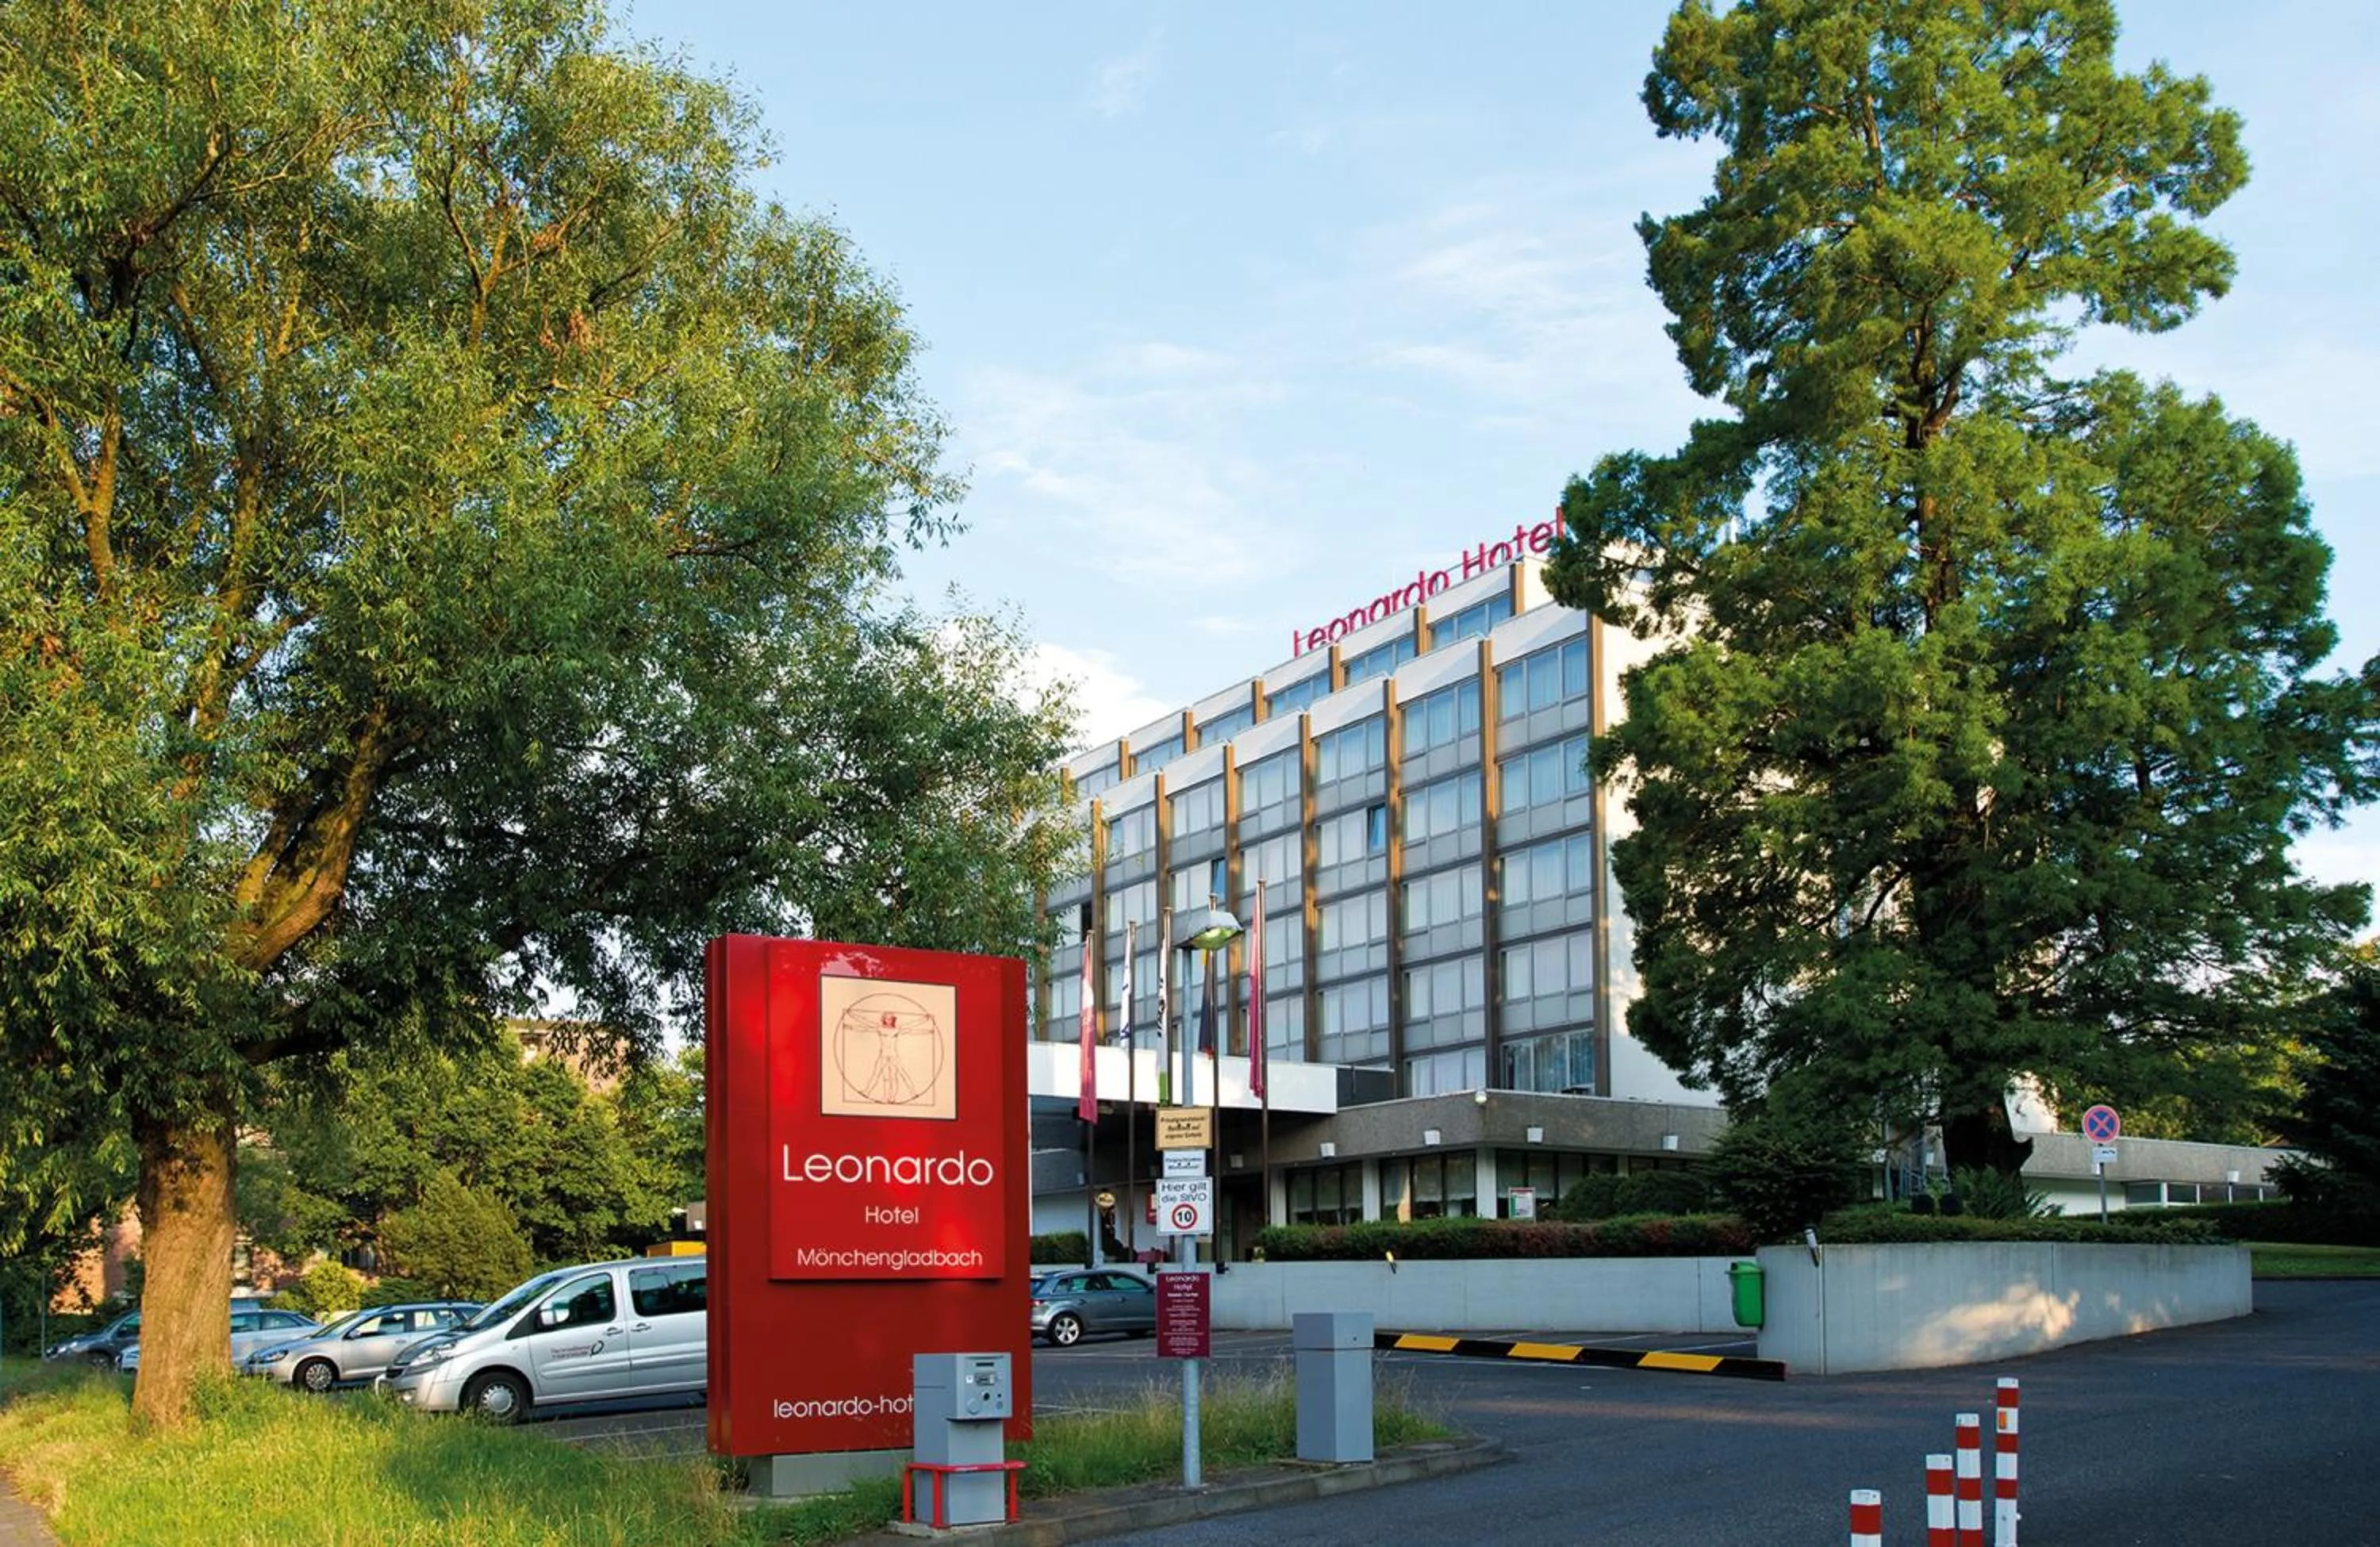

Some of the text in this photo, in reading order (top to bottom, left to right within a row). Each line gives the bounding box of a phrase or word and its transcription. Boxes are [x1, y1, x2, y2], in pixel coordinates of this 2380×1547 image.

[1461, 506, 1566, 580] Hotel
[782, 1143, 994, 1186] Leonardo
[865, 1205, 919, 1224] Hotel
[1177, 1211, 1192, 1223] 10
[797, 1248, 983, 1269] Mönchengladbach
[774, 1393, 914, 1418] leonardo-hot
